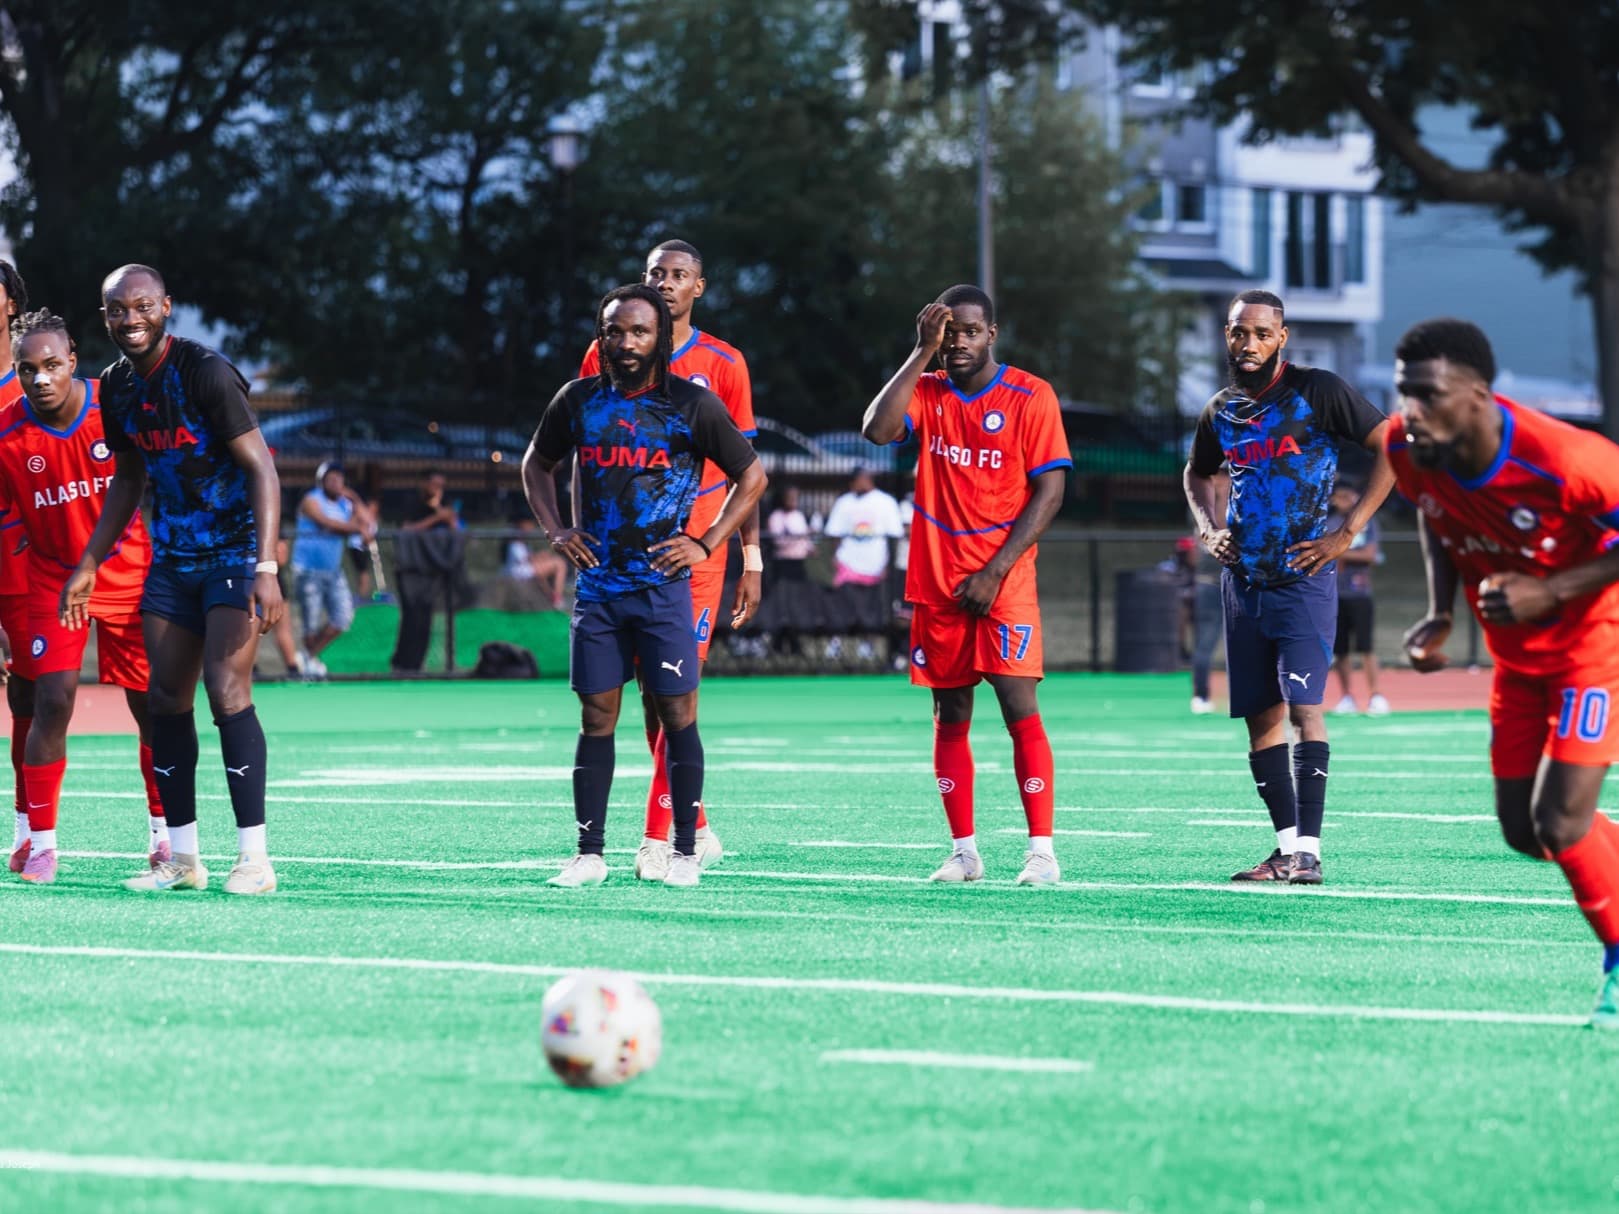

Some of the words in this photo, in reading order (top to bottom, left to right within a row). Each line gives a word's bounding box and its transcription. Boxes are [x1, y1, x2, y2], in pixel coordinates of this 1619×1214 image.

[580, 446, 671, 469] PUMA
[978, 448, 1002, 469] FC
[34, 480, 90, 509] ALASO
[694, 607, 710, 643] 6
[998, 623, 1033, 661] 17
[1558, 687, 1609, 742] 10
